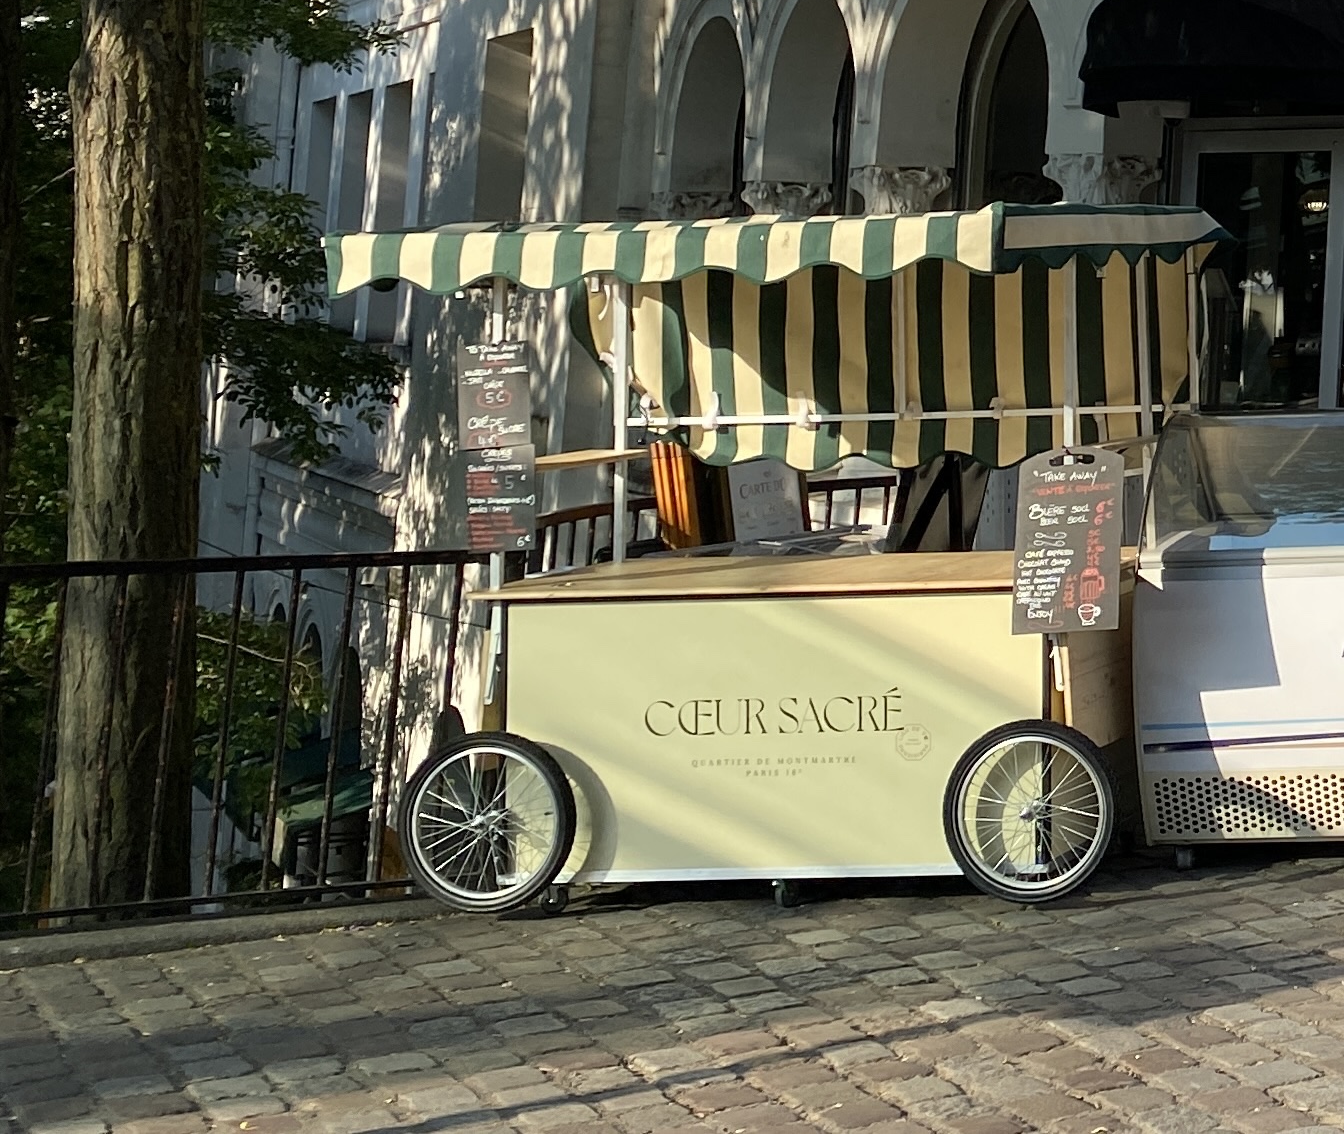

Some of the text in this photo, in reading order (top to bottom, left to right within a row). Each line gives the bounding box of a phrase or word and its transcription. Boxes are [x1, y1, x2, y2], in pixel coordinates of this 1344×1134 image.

[644, 686, 905, 737] CŒUR SACRÉ
[691, 758, 751, 768] QUARTIER
[756, 757, 771, 766] DE
[745, 768, 780, 777] PARIS
